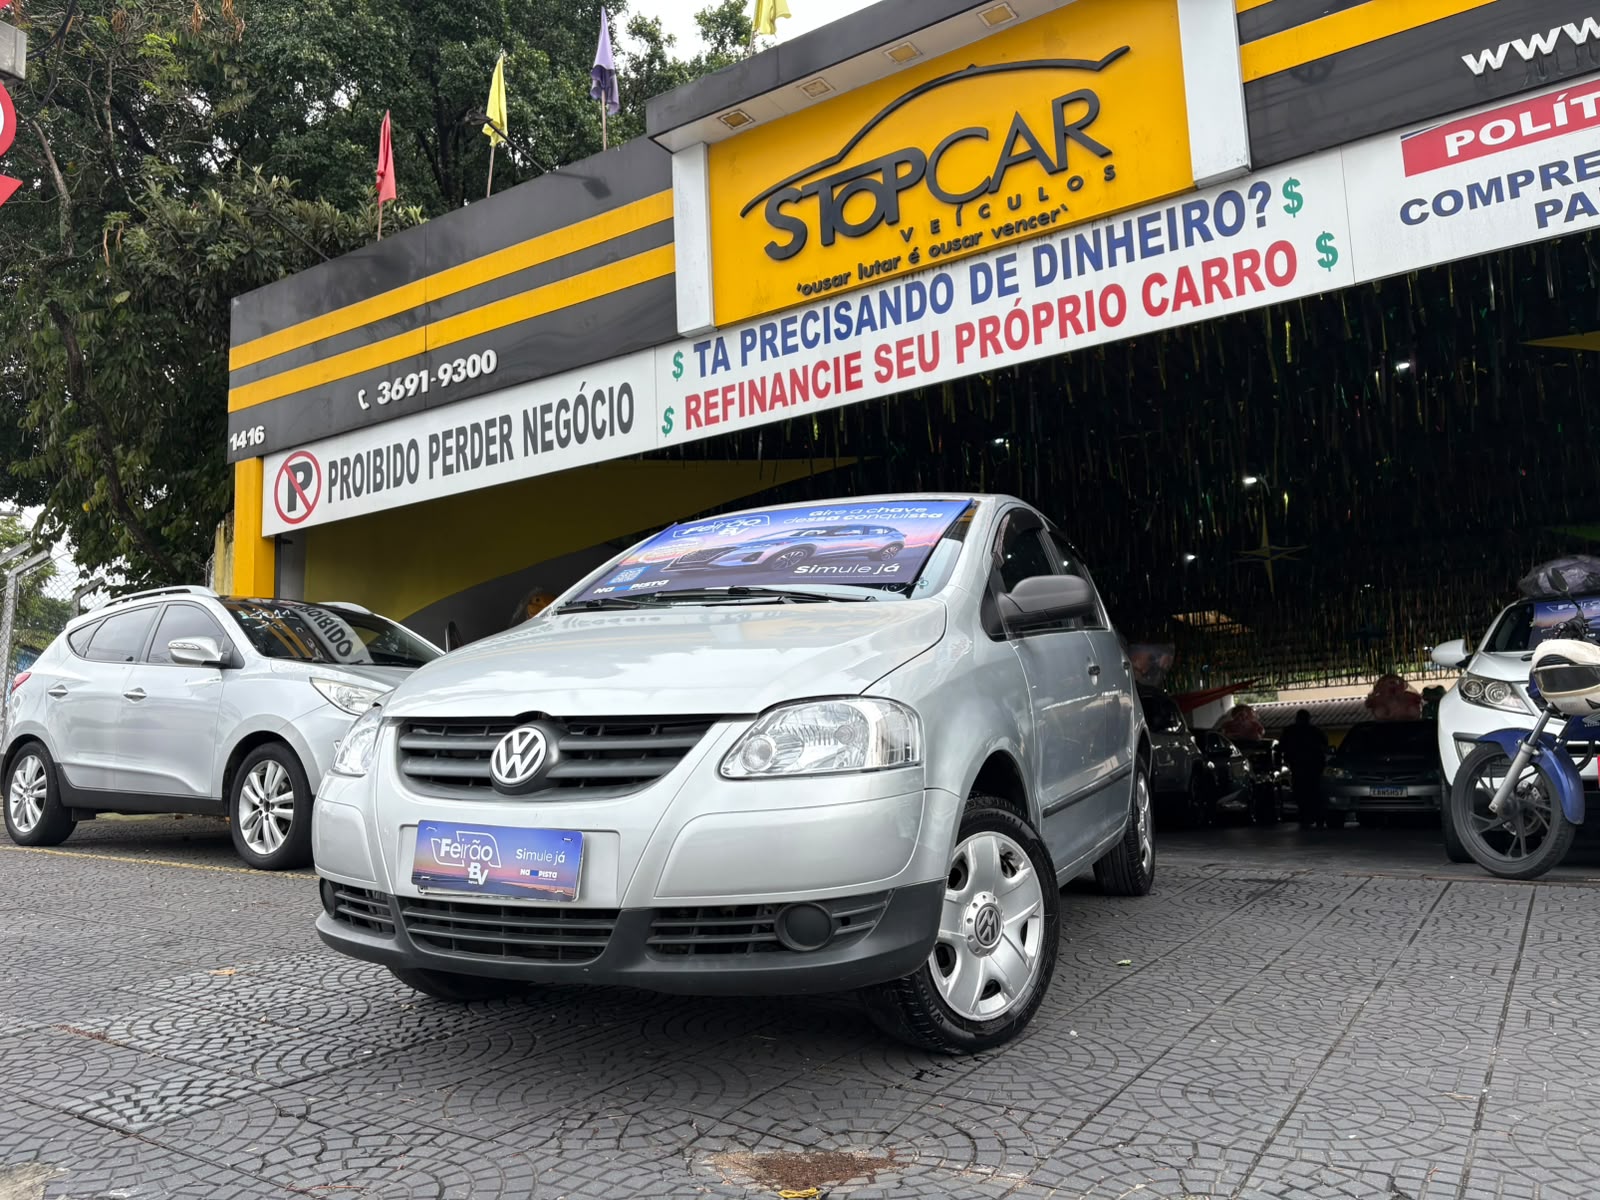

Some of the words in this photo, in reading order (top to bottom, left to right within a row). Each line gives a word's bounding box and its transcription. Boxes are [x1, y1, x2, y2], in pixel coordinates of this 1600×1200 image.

[764, 88, 1113, 260] STOPCAR
[1534, 187, 1600, 229] PA
[857, 255, 901, 280] lutar
[908, 247, 920, 264] é
[928, 231, 983, 257] ousar
[693, 336, 731, 378] TA
[740, 273, 954, 368] PRECISANDO
[969, 253, 1020, 305] DE
[1033, 180, 1272, 288] DINHEIRO?
[685, 350, 863, 431] REFINANCIE
[874, 330, 940, 384] SEU
[955, 283, 1127, 364] PRÓPRIO
[1141, 239, 1297, 317] CARRO
[377, 349, 498, 405] 3691-9300
[229, 425, 265, 451] 1416
[328, 438, 420, 504] PROIBIDO
[428, 414, 514, 479] PERDER
[523, 382, 634, 458] NEGÓCIO
[784, 515, 843, 524] dessa
[843, 512, 944, 520] conquista
[794, 564, 872, 574] Simule
[873, 563, 901, 575] já
[440, 838, 493, 862] Feirão
[515, 848, 553, 862] Simule
[553, 850, 566, 865] já
